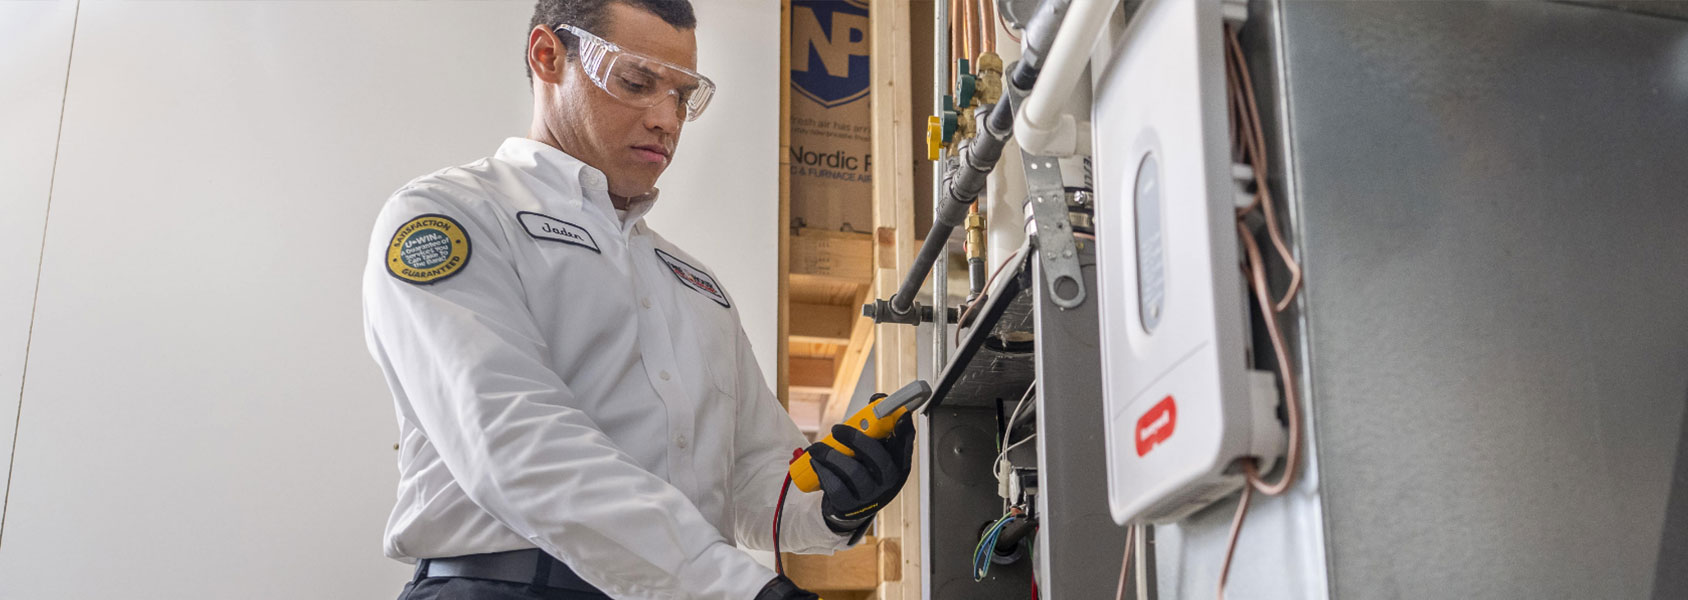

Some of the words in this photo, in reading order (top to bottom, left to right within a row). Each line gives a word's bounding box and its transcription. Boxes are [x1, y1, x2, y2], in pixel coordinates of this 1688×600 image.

[791, 5, 870, 78] NP
[790, 146, 858, 170] Nordic
[808, 168, 855, 182] FURNACE
[394, 220, 451, 247] SATISFACTION
[542, 223, 584, 241] Jaden
[401, 256, 460, 278] GUARANTEED
